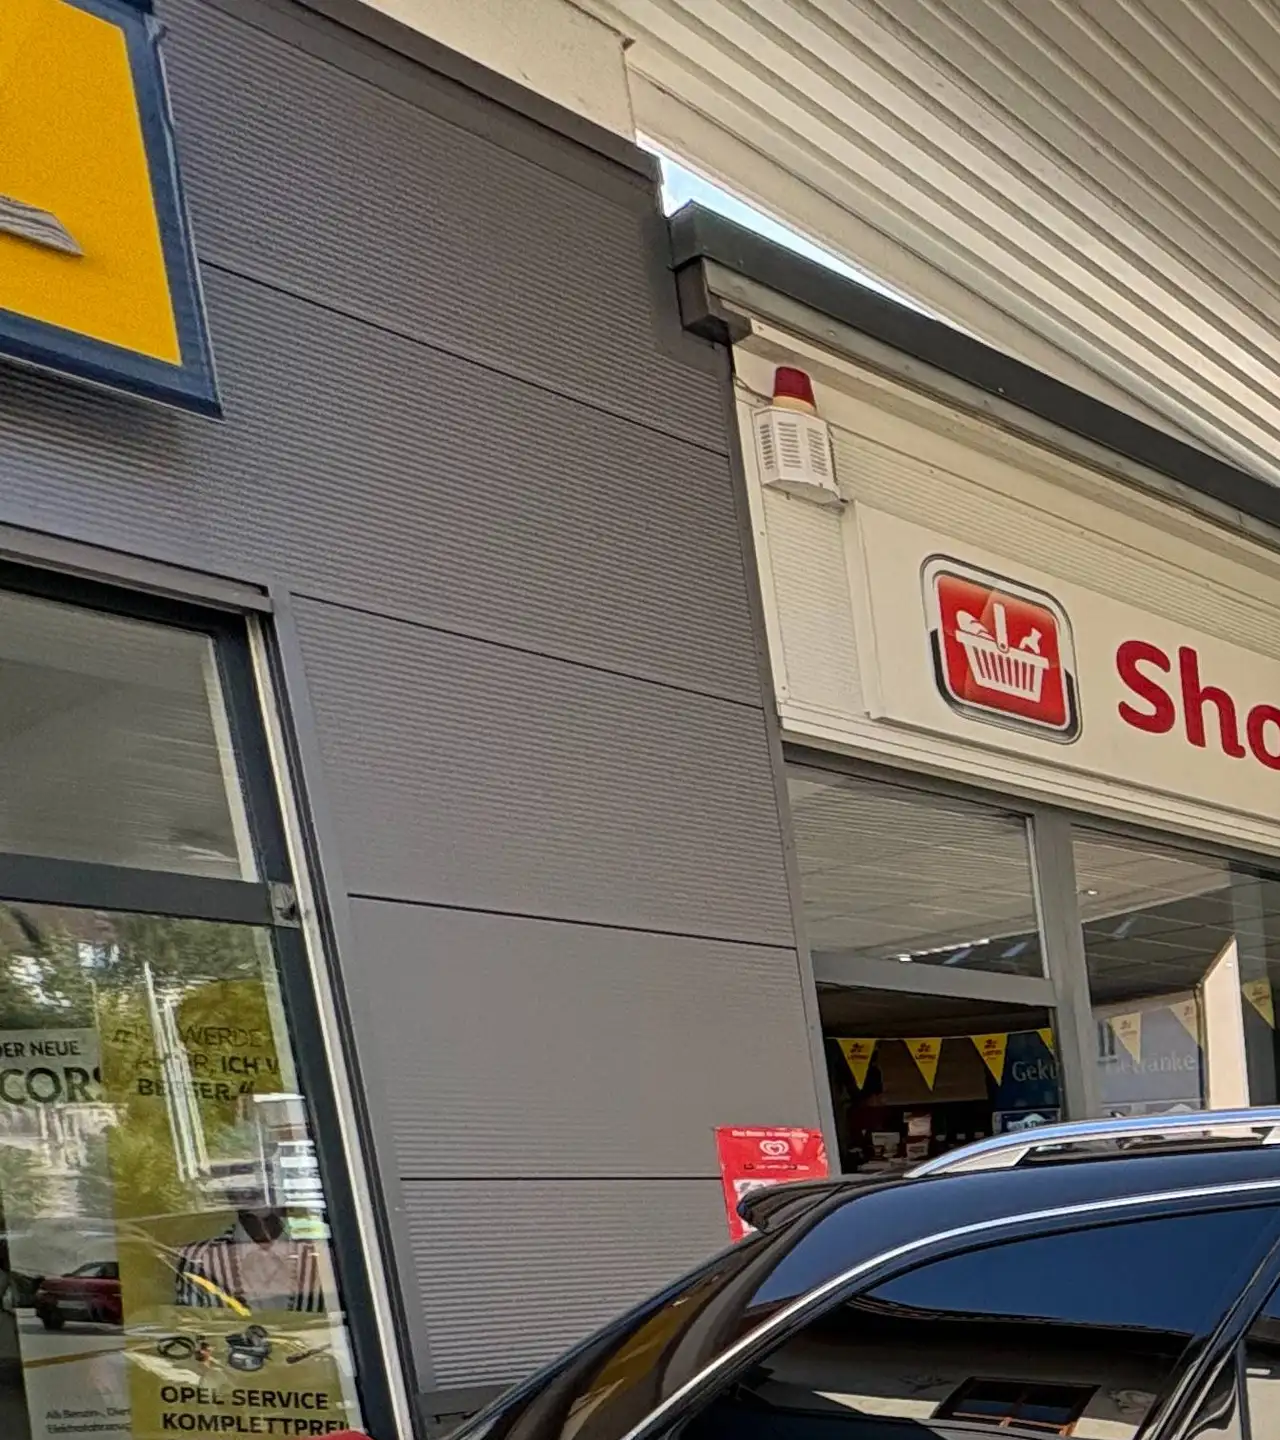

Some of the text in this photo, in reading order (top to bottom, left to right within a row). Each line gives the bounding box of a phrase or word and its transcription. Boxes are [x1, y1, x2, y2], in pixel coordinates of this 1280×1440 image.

[0, 1041, 81, 1058] ER NEUE
[161, 1386, 329, 1410] OPEL SERVICE
[163, 1413, 350, 1436] KOMPLETTPREI
